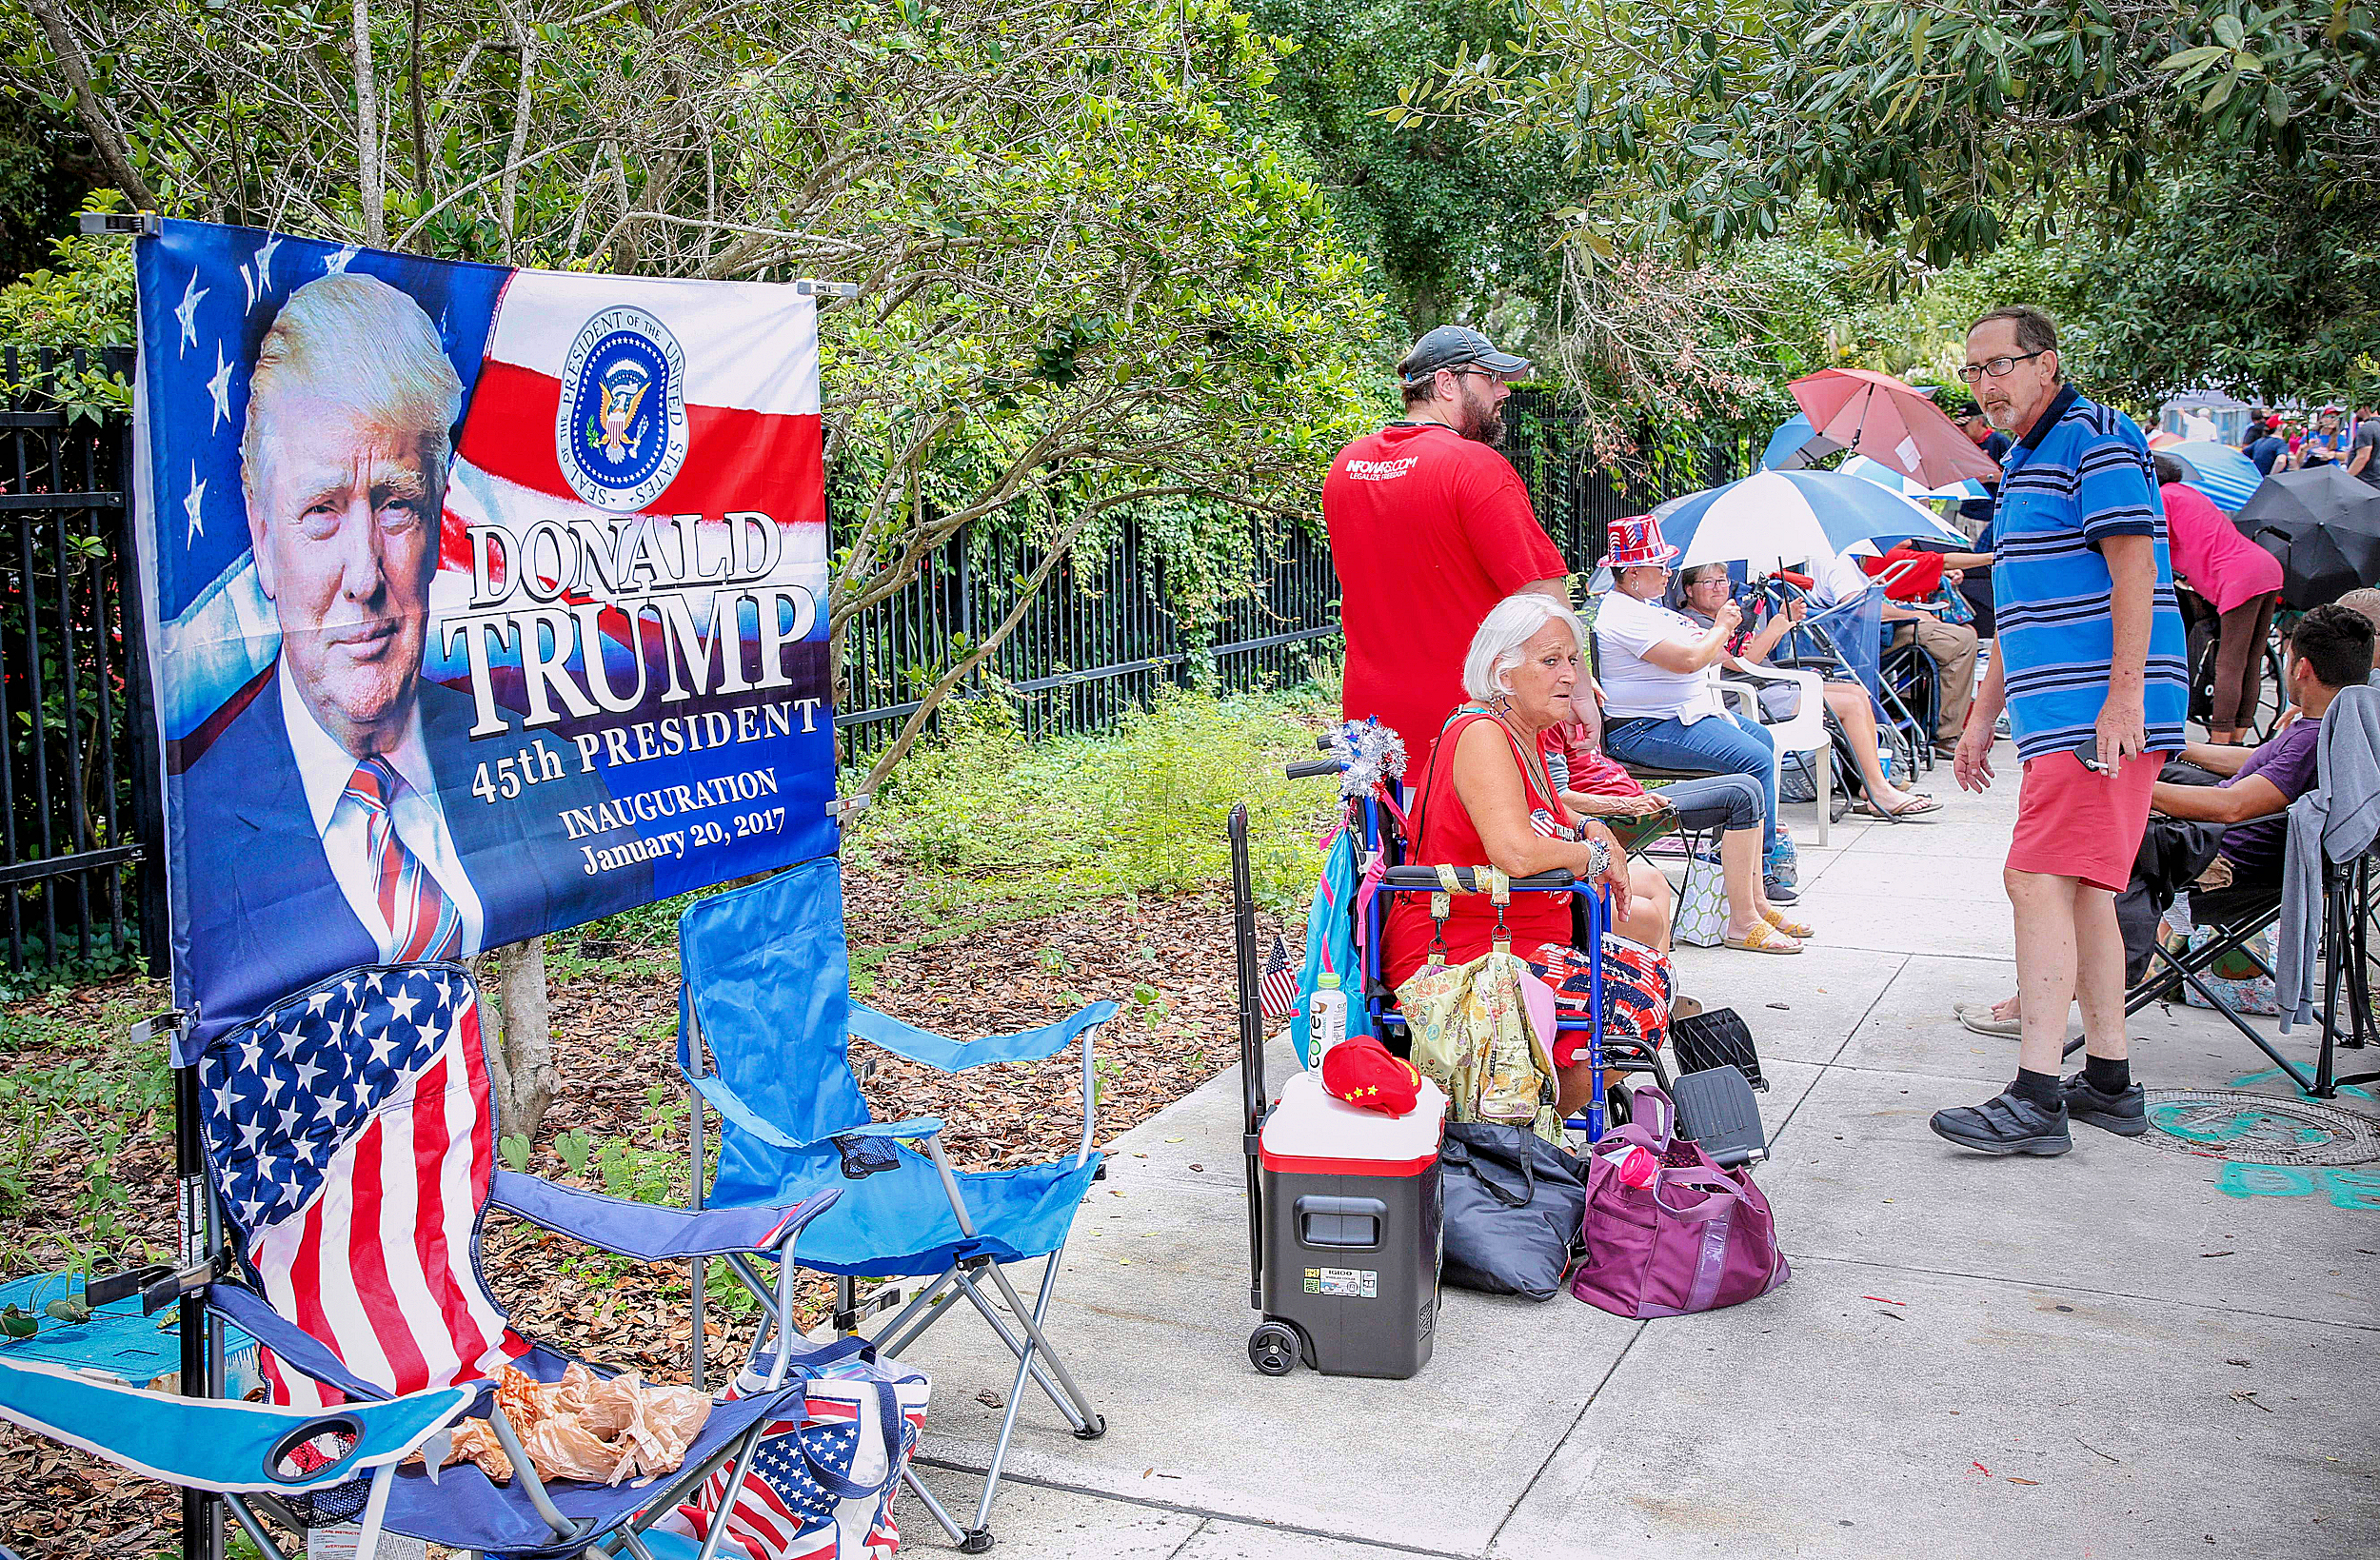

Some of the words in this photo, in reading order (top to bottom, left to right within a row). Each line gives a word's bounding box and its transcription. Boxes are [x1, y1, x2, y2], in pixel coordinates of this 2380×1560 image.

[626, 314, 640, 327] OF
[645, 320, 662, 342] THE
[564, 311, 623, 405] PRESIDENT
[665, 341, 684, 426] UNITED
[560, 414, 568, 444] THE
[562, 447, 570, 464] OF
[570, 464, 606, 505] SEAL
[636, 442, 684, 504] STATES
[1345, 456, 1419, 474] INFOWARS.COM
[1349, 472, 1380, 481] LEGALIZE
[1381, 470, 1407, 481] FREEDOM
[465, 511, 783, 610] DONALD
[441, 584, 817, 741] TRUMP
[471, 739, 566, 804] 45th
[572, 697, 822, 774] PRESIDENT
[558, 767, 779, 840] INAUGURATION
[580, 829, 685, 876] January
[689, 820, 731, 847] 20,
[733, 806, 786, 837] 2017
